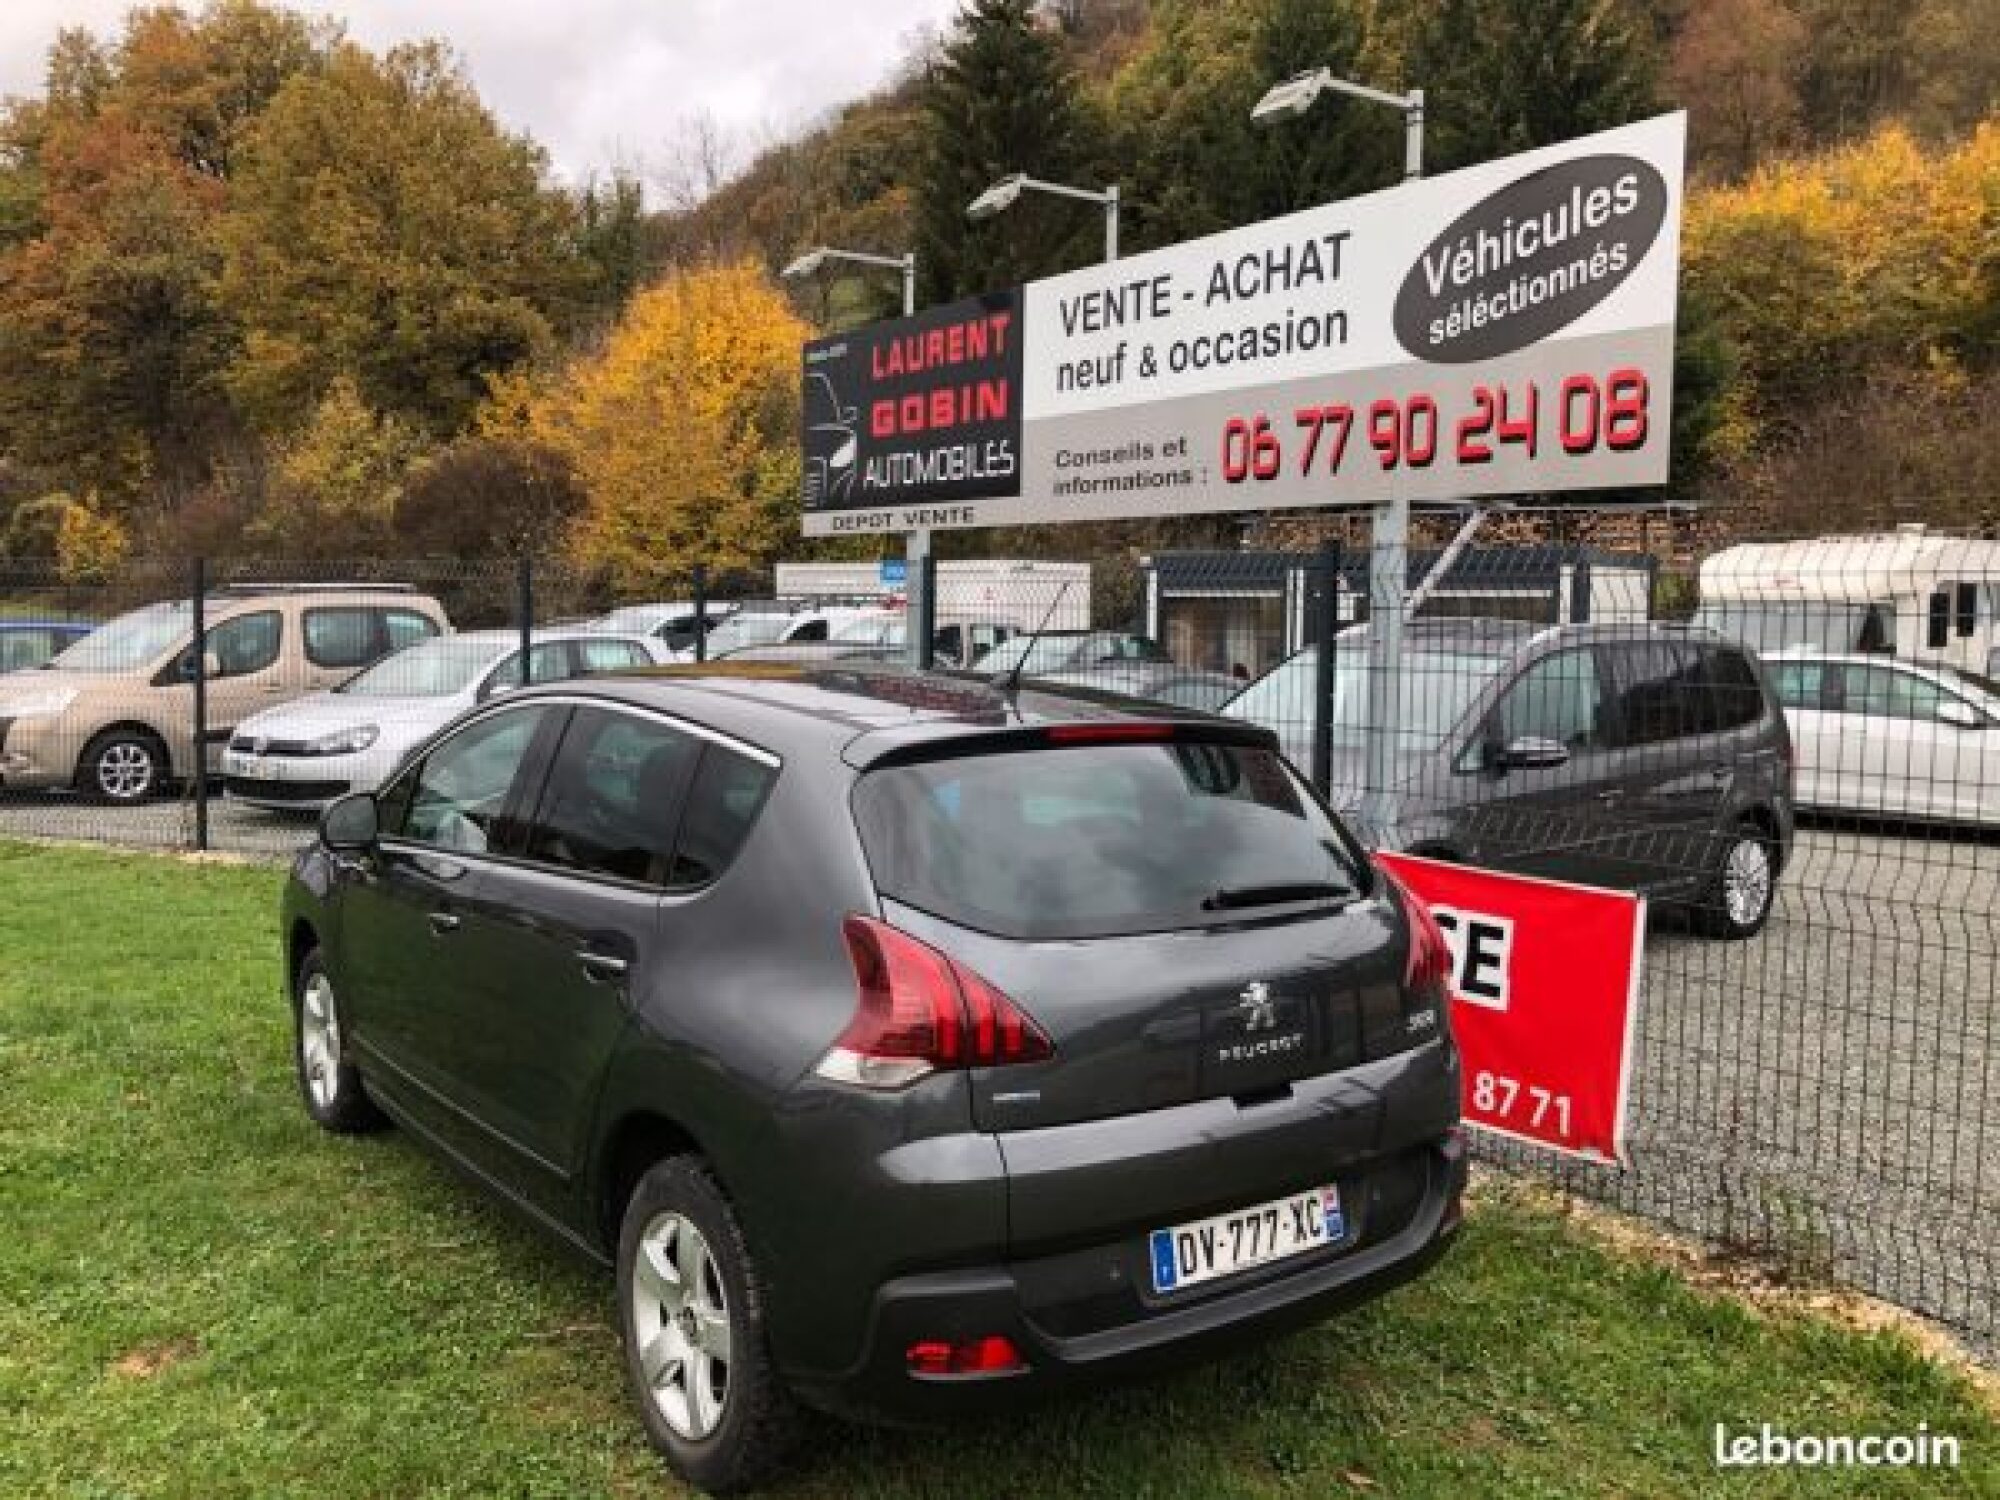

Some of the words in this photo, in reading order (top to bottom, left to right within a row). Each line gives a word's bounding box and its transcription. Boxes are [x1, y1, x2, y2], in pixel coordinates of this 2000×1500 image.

[1422, 173, 1638, 298] Véhicules
[1059, 273, 1173, 337] VENTE
[1203, 230, 1353, 307] ACHAT
[1429, 240, 1628, 345] séléctionnés
[872, 313, 1011, 380] LAURENT
[1056, 340, 1128, 391] neuf
[1139, 344, 1158, 378] &
[1168, 308, 1348, 373] occasion
[869, 379, 1009, 439] GOBIN
[1221, 412, 1281, 484] 06
[1294, 404, 1354, 478] 77
[1367, 392, 1439, 472] 90
[1456, 379, 1539, 465] 24
[1560, 367, 1649, 453] 08
[862, 439, 1015, 490] AUTOMOBILES
[1055, 440, 1155, 468] Conseils
[1162, 436, 1187, 458] et
[903, 506, 976, 527] VENTE
[1473, 1070, 1521, 1118] 87
[1528, 1086, 1571, 1137] 71
